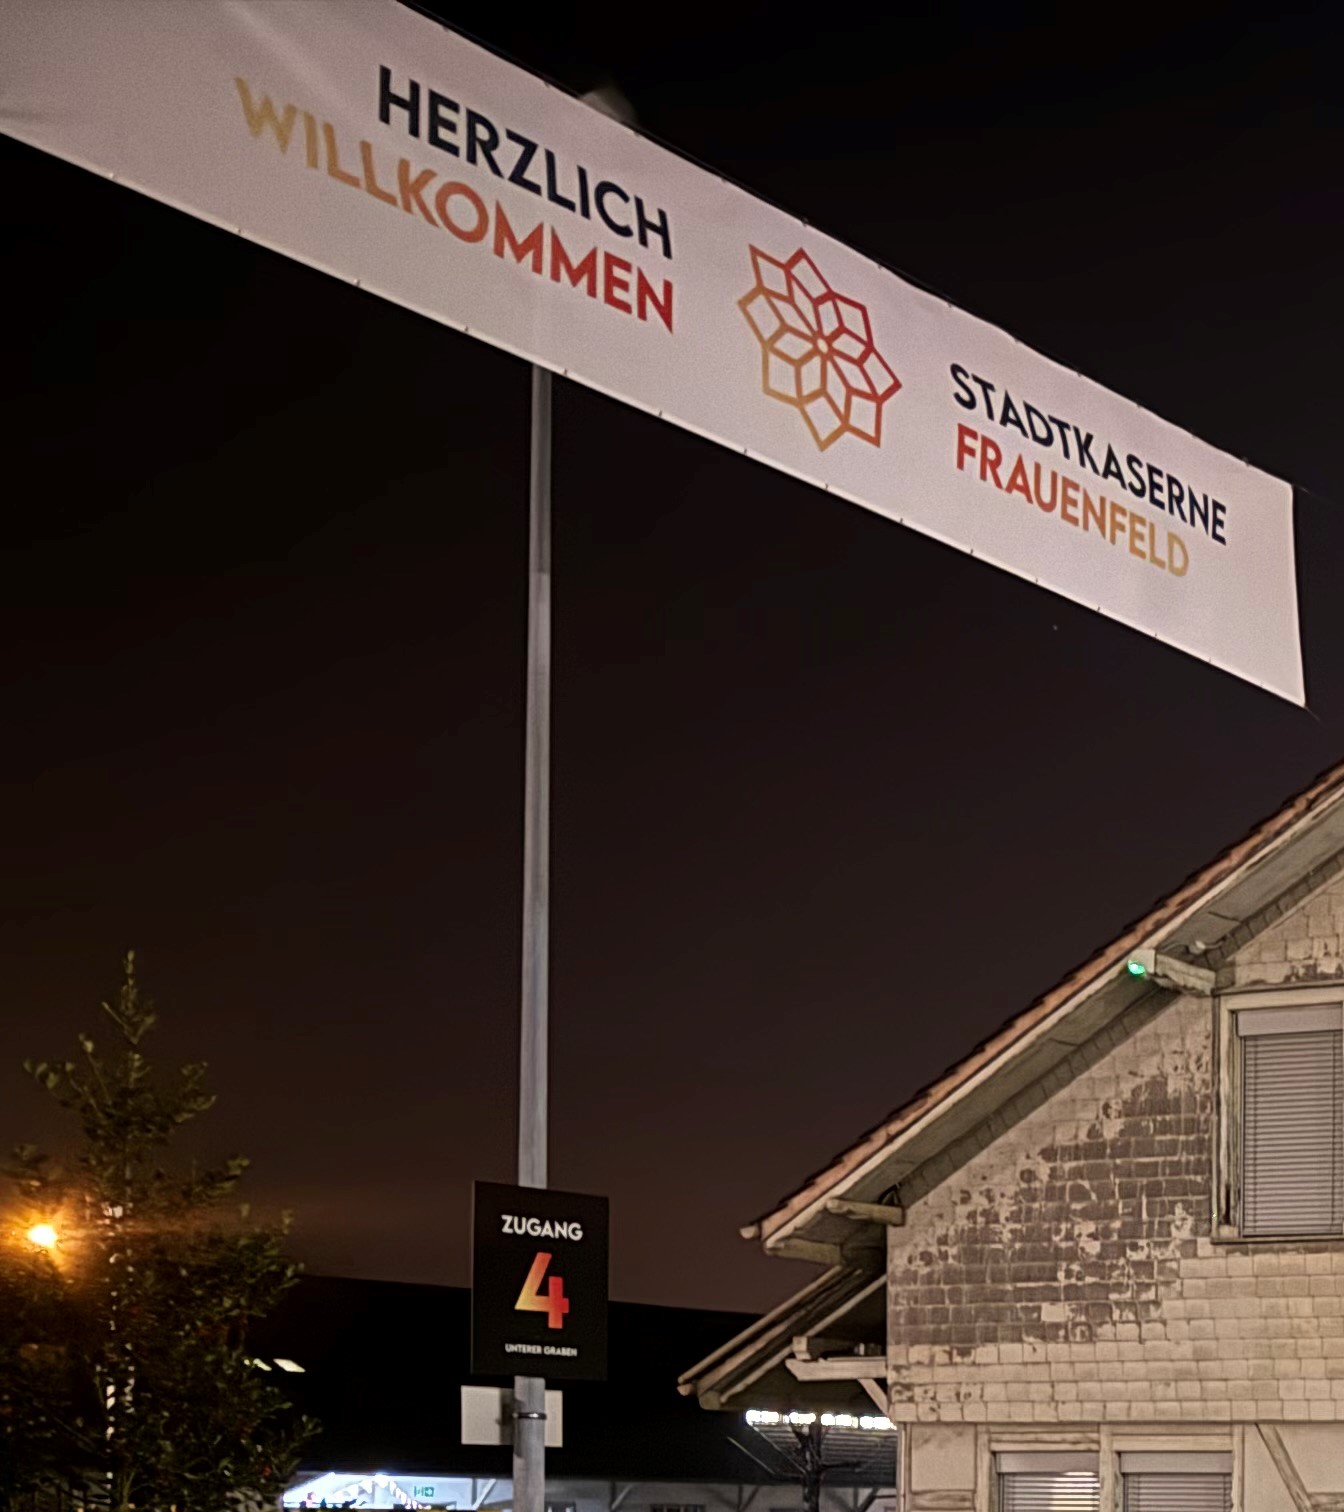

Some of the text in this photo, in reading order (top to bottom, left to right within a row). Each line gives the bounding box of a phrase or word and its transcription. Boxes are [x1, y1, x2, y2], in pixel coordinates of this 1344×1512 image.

[233, 76, 674, 335] WILLKOMMEN
[378, 64, 674, 259] HERZLICH
[950, 362, 1227, 546] STADTKASERNE
[956, 423, 1190, 578] FRAUENFELD
[501, 1214, 583, 1242] ZUGANG
[514, 1252, 570, 1330] 4
[504, 1343, 578, 1357] UNTERER GRABEN
